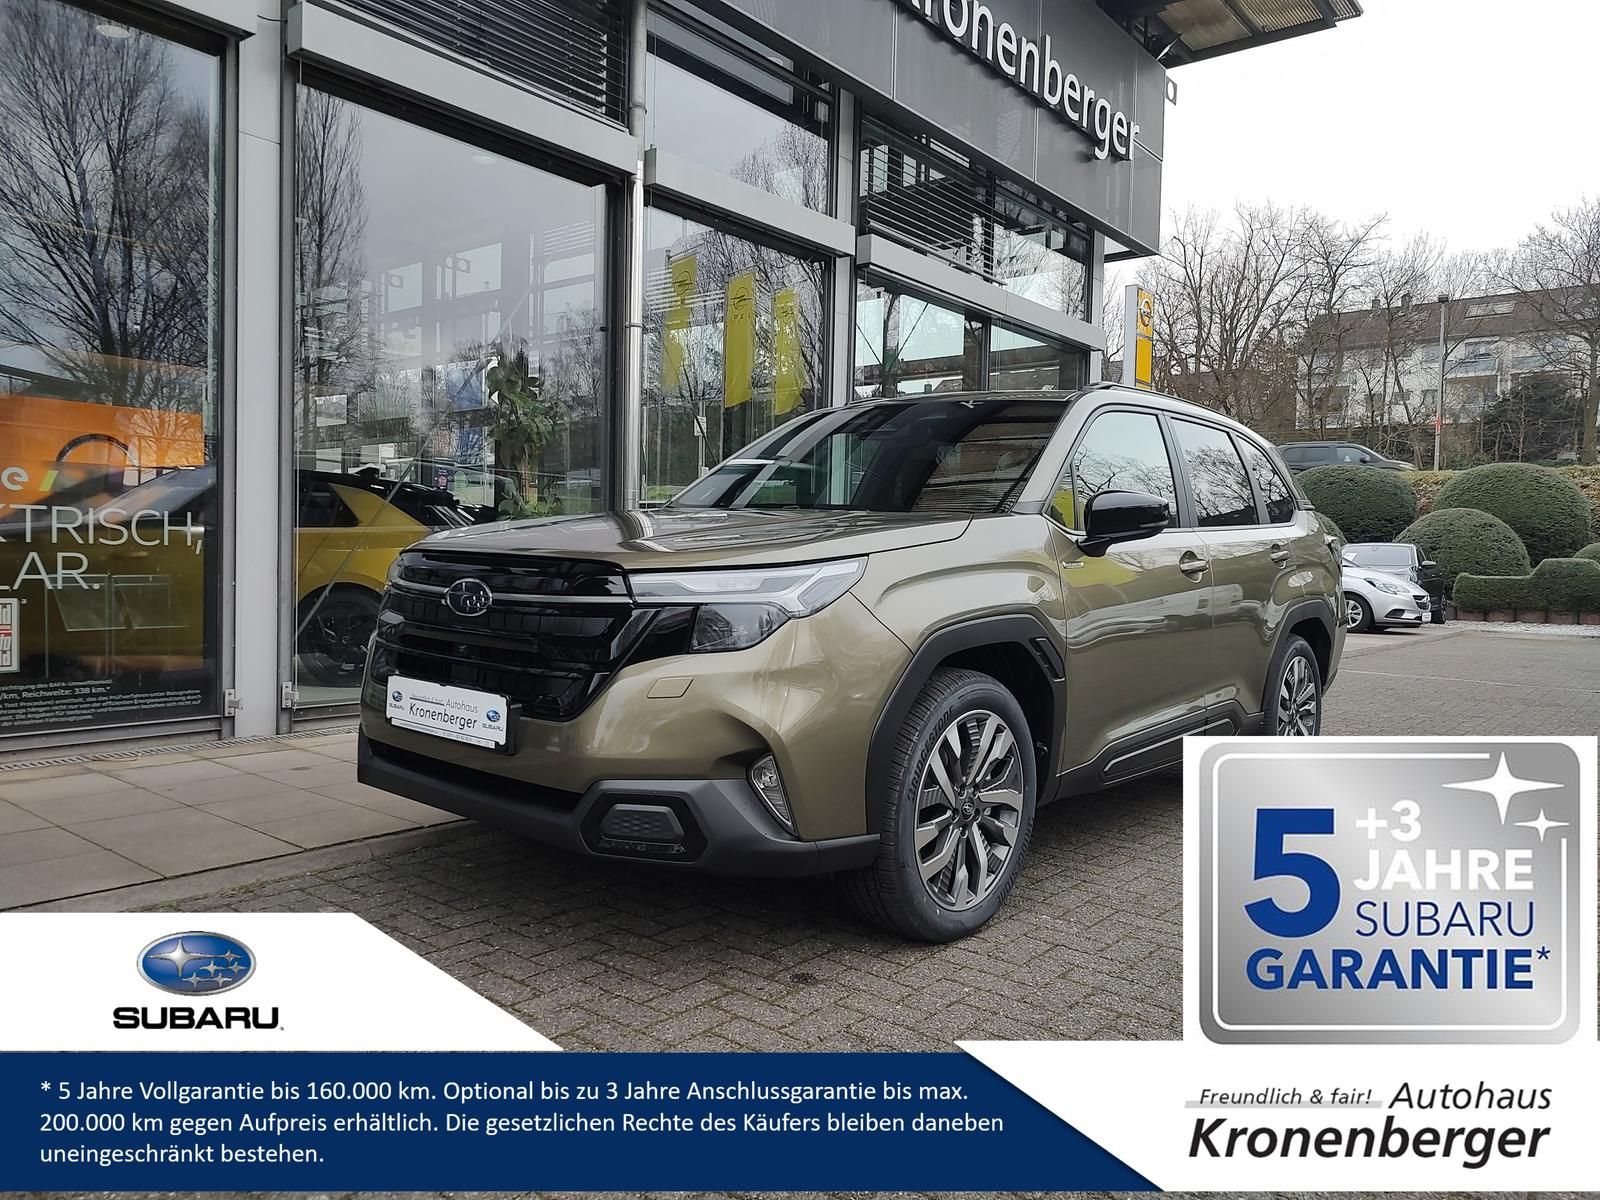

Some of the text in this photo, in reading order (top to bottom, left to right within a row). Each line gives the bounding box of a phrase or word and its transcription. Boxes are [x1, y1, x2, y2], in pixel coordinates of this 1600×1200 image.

[911, 0, 1140, 160] onenberger
[0, 551, 100, 590] AR.
[74, 687, 91, 695] 338
[409, 702, 478, 730] Kronenberger
[446, 698, 479, 714] Autohaus
